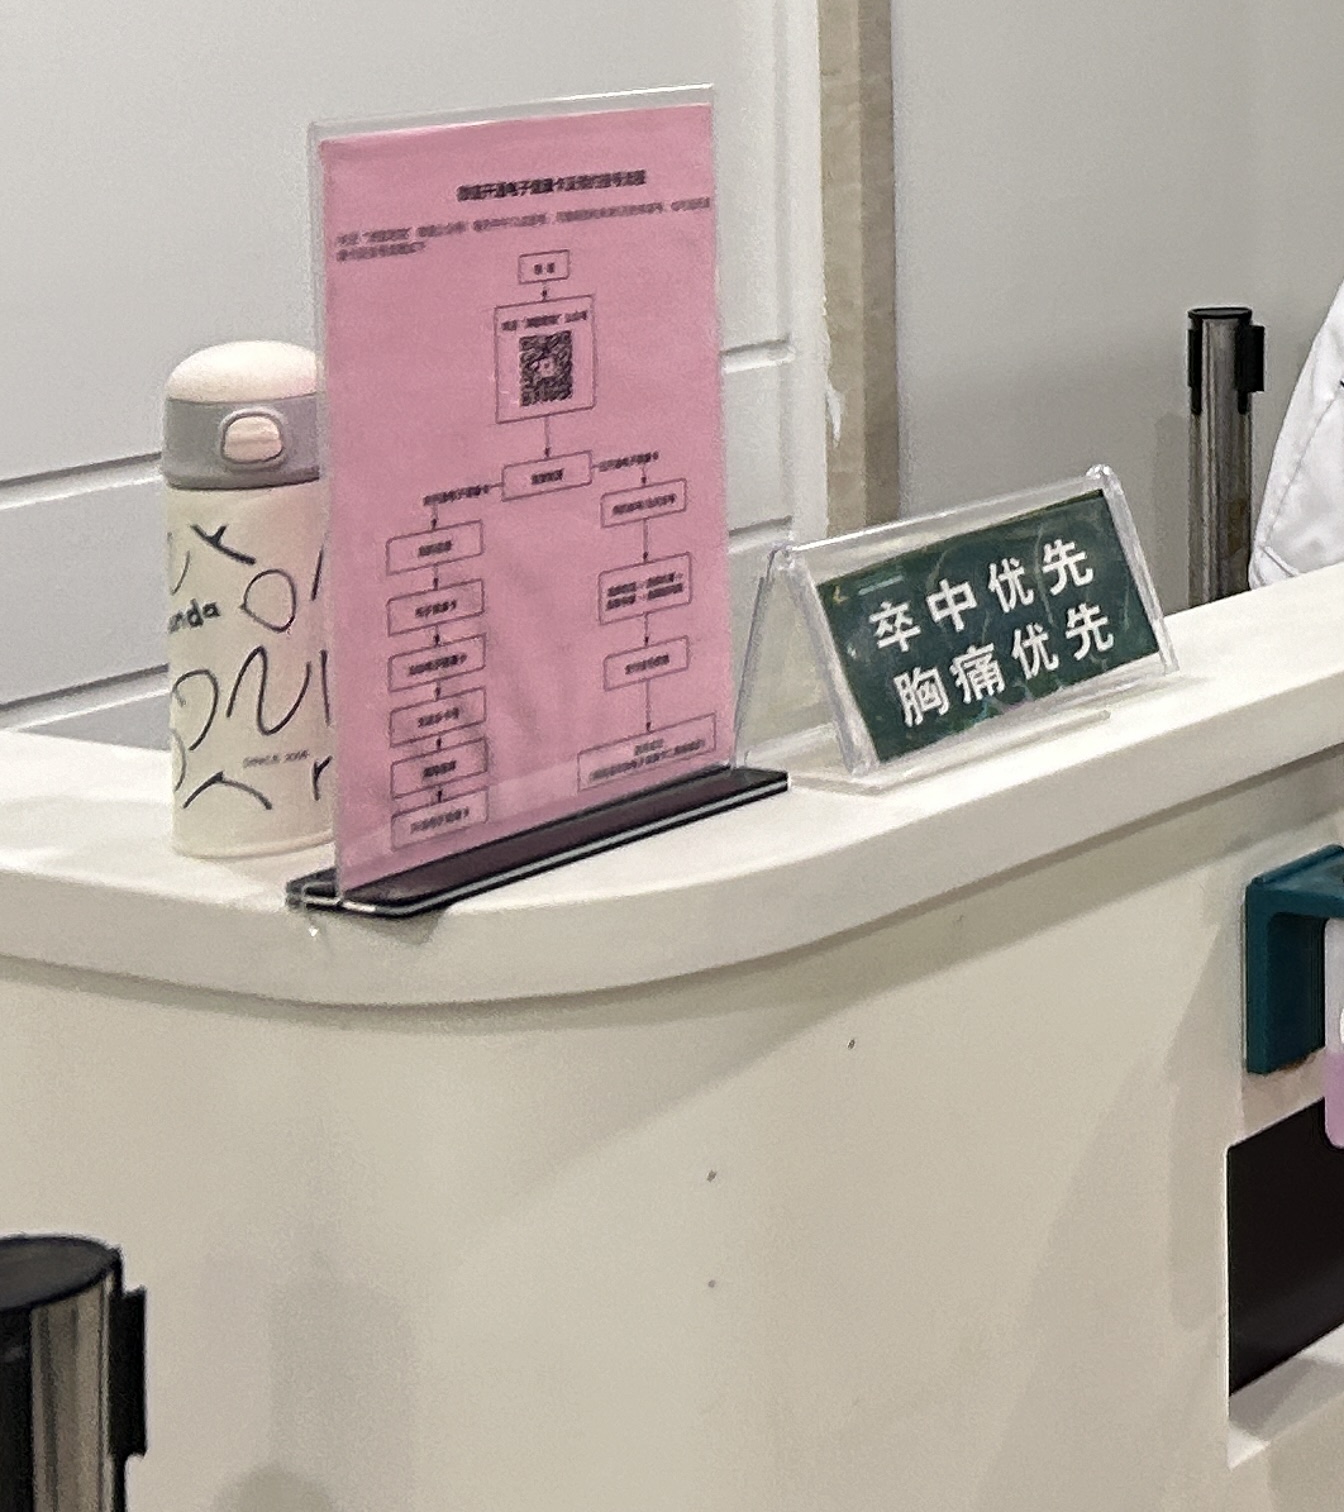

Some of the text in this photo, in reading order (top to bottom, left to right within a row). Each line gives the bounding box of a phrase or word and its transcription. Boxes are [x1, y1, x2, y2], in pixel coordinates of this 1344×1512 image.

[868, 538, 1095, 652] 卒中优先
[892, 602, 1115, 728] 胸痛优先
